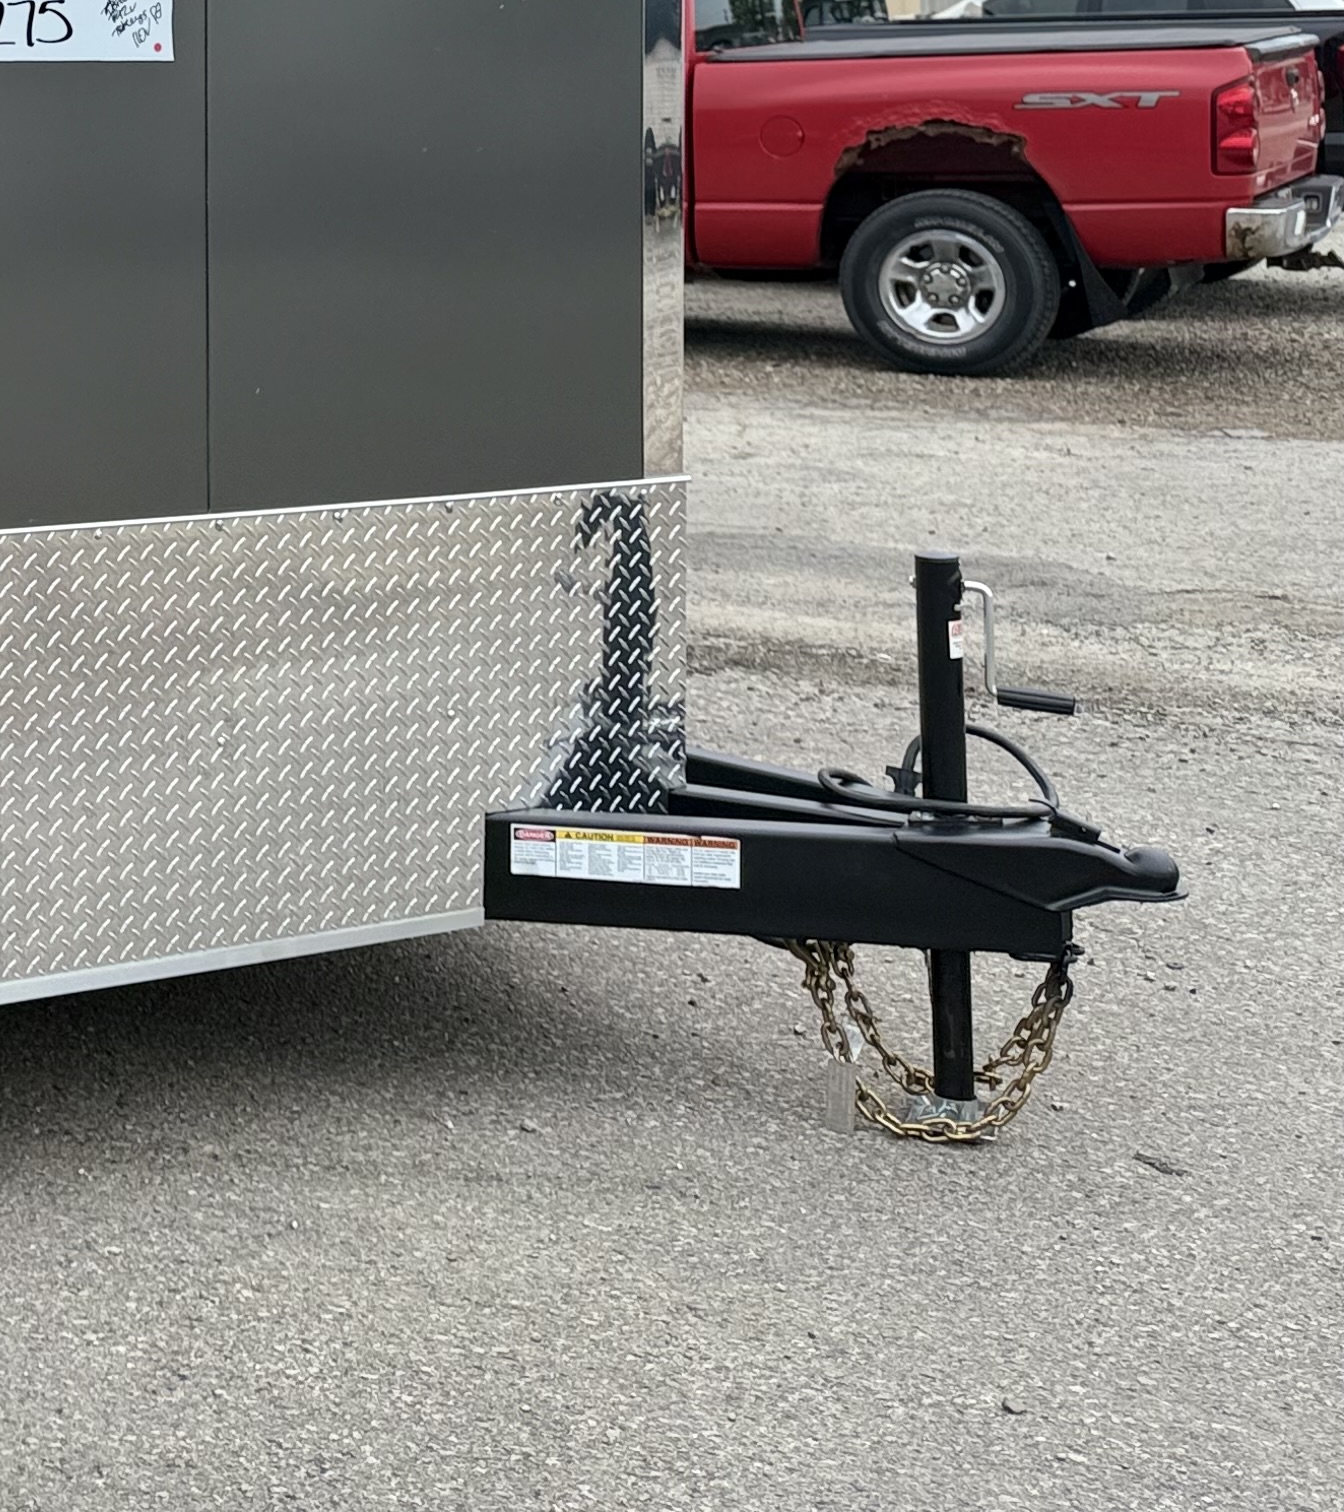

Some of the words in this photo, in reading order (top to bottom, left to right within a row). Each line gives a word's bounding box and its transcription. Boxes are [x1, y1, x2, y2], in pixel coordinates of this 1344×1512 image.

[1014, 90, 1181, 110] SXT
[575, 832, 614, 842] CAUTION
[646, 837, 690, 846] WARNING
